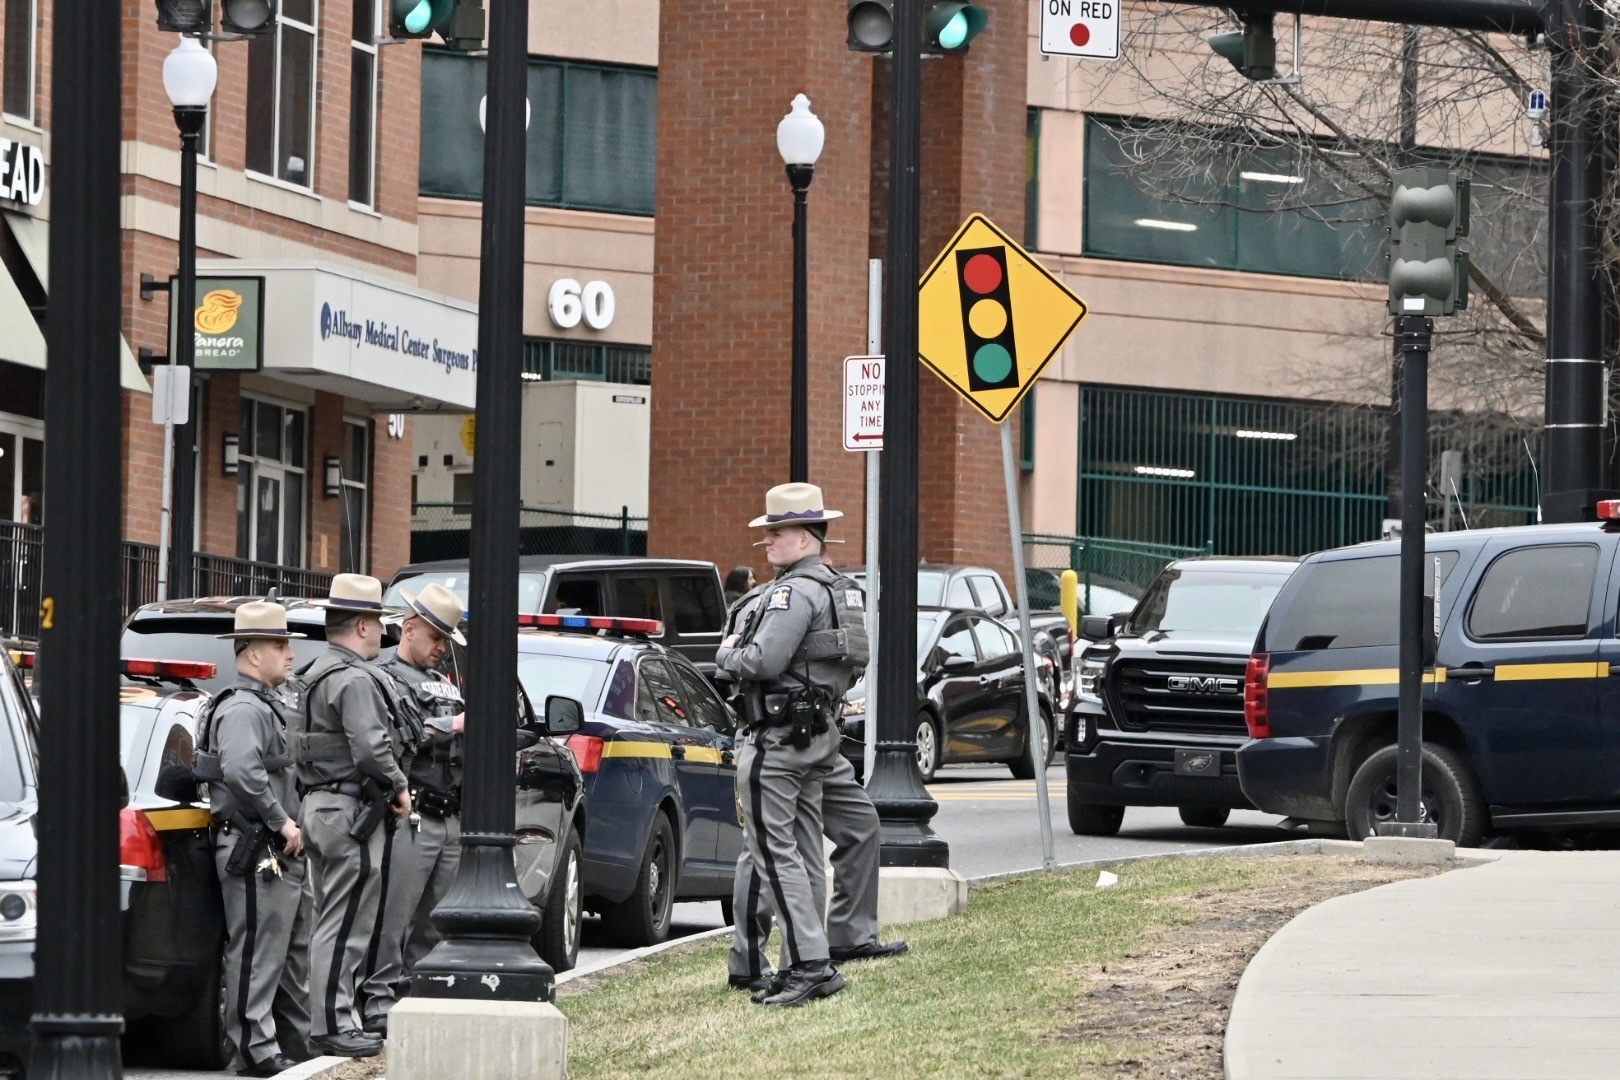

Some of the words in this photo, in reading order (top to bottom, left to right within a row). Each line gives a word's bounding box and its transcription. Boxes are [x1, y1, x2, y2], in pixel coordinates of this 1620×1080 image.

[1049, 0, 1071, 16] ON
[1080, 1, 1112, 19] RED
[0, 137, 45, 206] EAD
[548, 278, 615, 330] 60
[332, 310, 363, 349] Albany
[365, 319, 399, 352] Medical
[401, 329, 430, 360] Center
[432, 338, 470, 375] Surgeons
[195, 348, 237, 357] BREAD
[861, 363, 881, 380] NO
[848, 384, 885, 397] STOPPI
[861, 400, 881, 412] ANY
[860, 415, 882, 428] TIME
[1167, 676, 1238, 693] GMC
